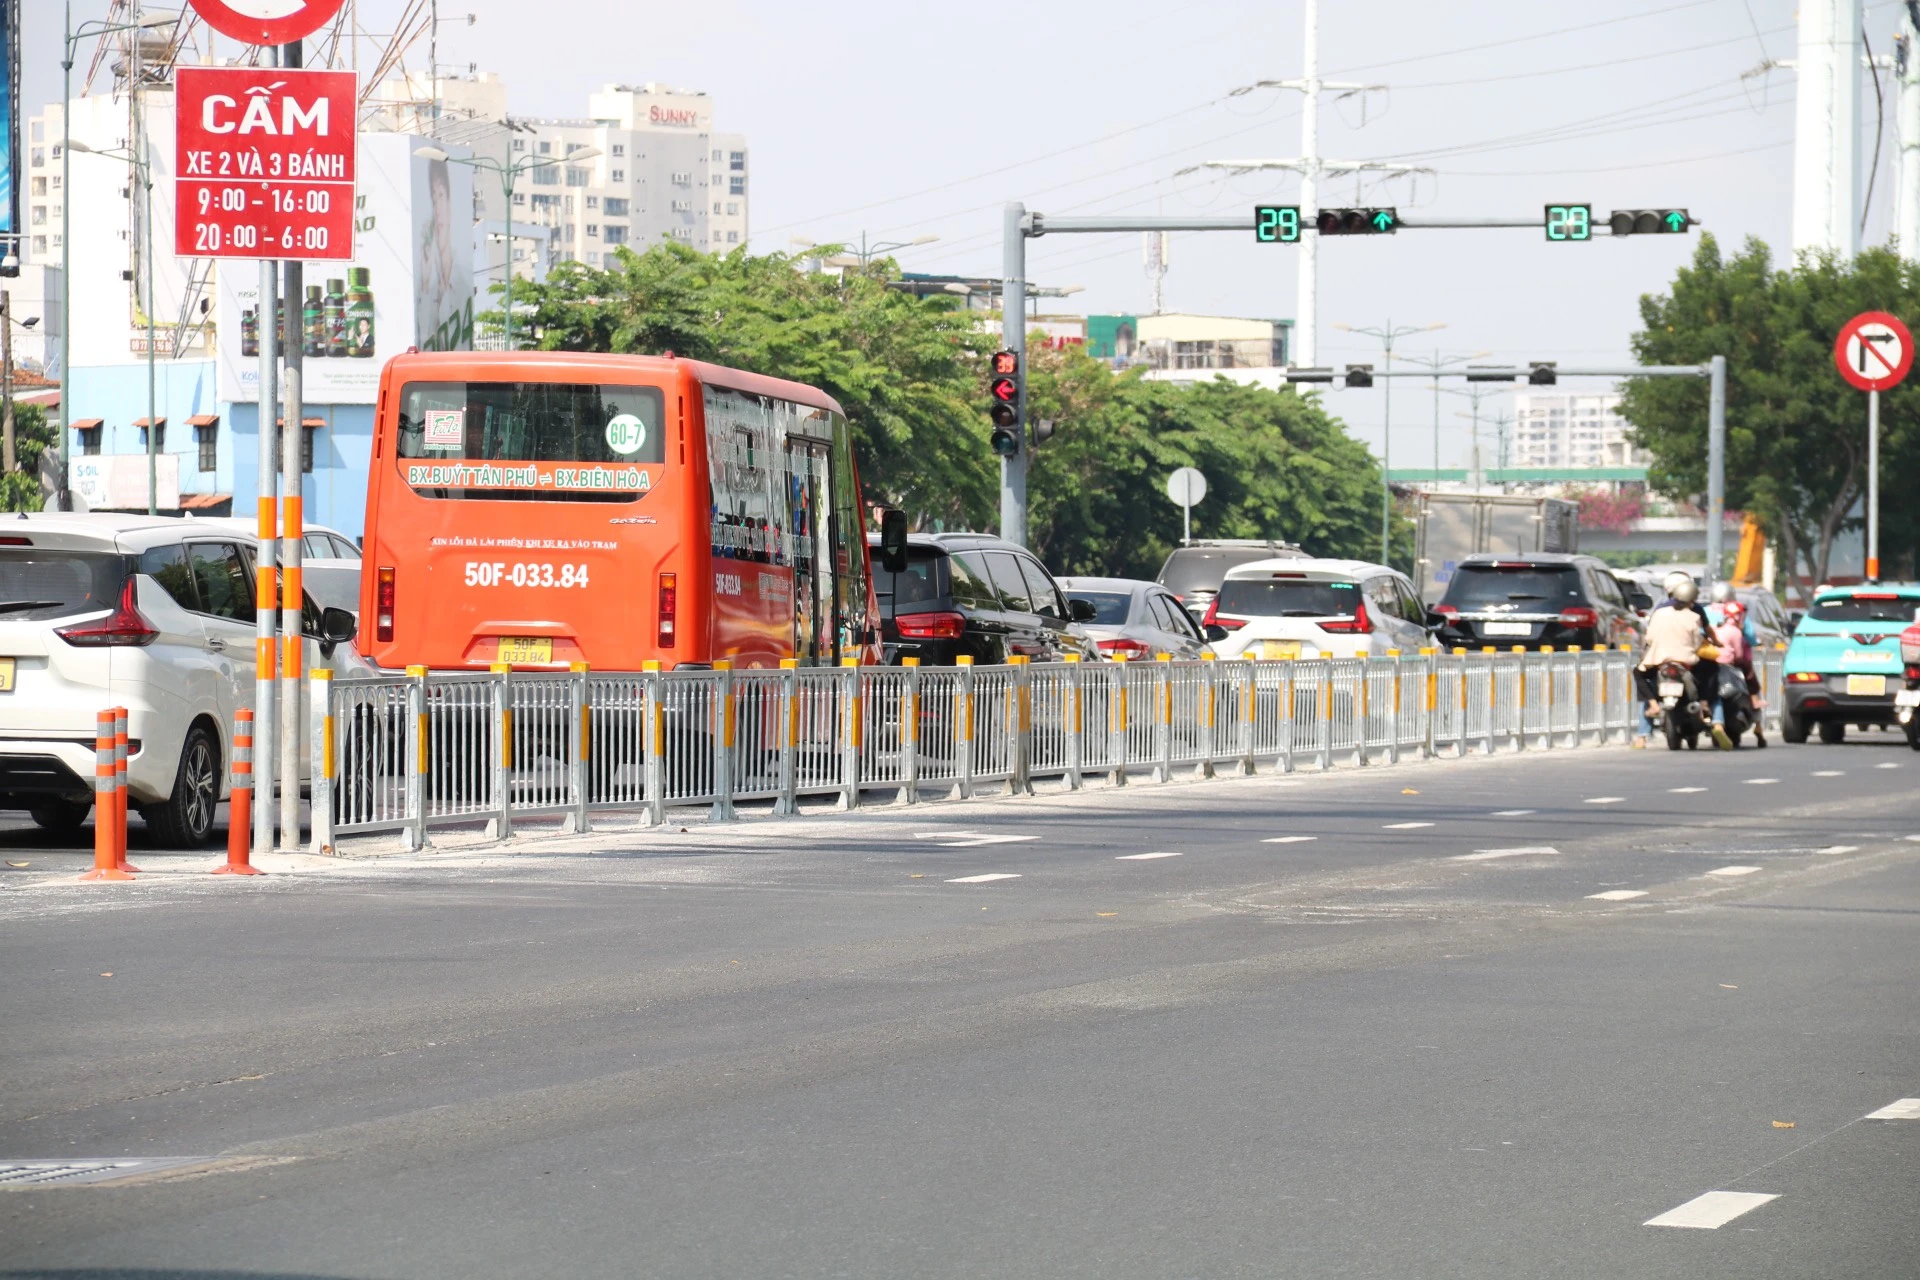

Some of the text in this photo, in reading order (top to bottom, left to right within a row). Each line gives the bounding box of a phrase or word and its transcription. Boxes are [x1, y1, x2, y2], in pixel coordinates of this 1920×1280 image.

[202, 81, 329, 136] CẤM
[650, 105, 697, 124] SUNNY
[186, 146, 344, 177] XE 2 VÀ 3 BÁNH
[197, 187, 246, 215] 9:00
[271, 189, 330, 214] 16:00
[1259, 208, 1298, 240] 29
[1548, 206, 1588, 239] 29
[195, 223, 257, 251] 20:00
[281, 225, 329, 250] 6:00
[997, 354, 1015, 374] 39
[611, 423, 642, 445] 60-7
[473, 463, 502, 486] TÂN
[505, 464, 537, 488] PHÚ
[555, 465, 613, 489] BX.BIÊN
[616, 466, 650, 490] HÒA
[431, 538, 447, 546] XIN
[543, 539, 554, 549] XE
[557, 539, 569, 549] RA
[464, 561, 589, 588] 50F-033.84
[503, 651, 545, 663] 033.84
[514, 637, 537, 650] 50F
